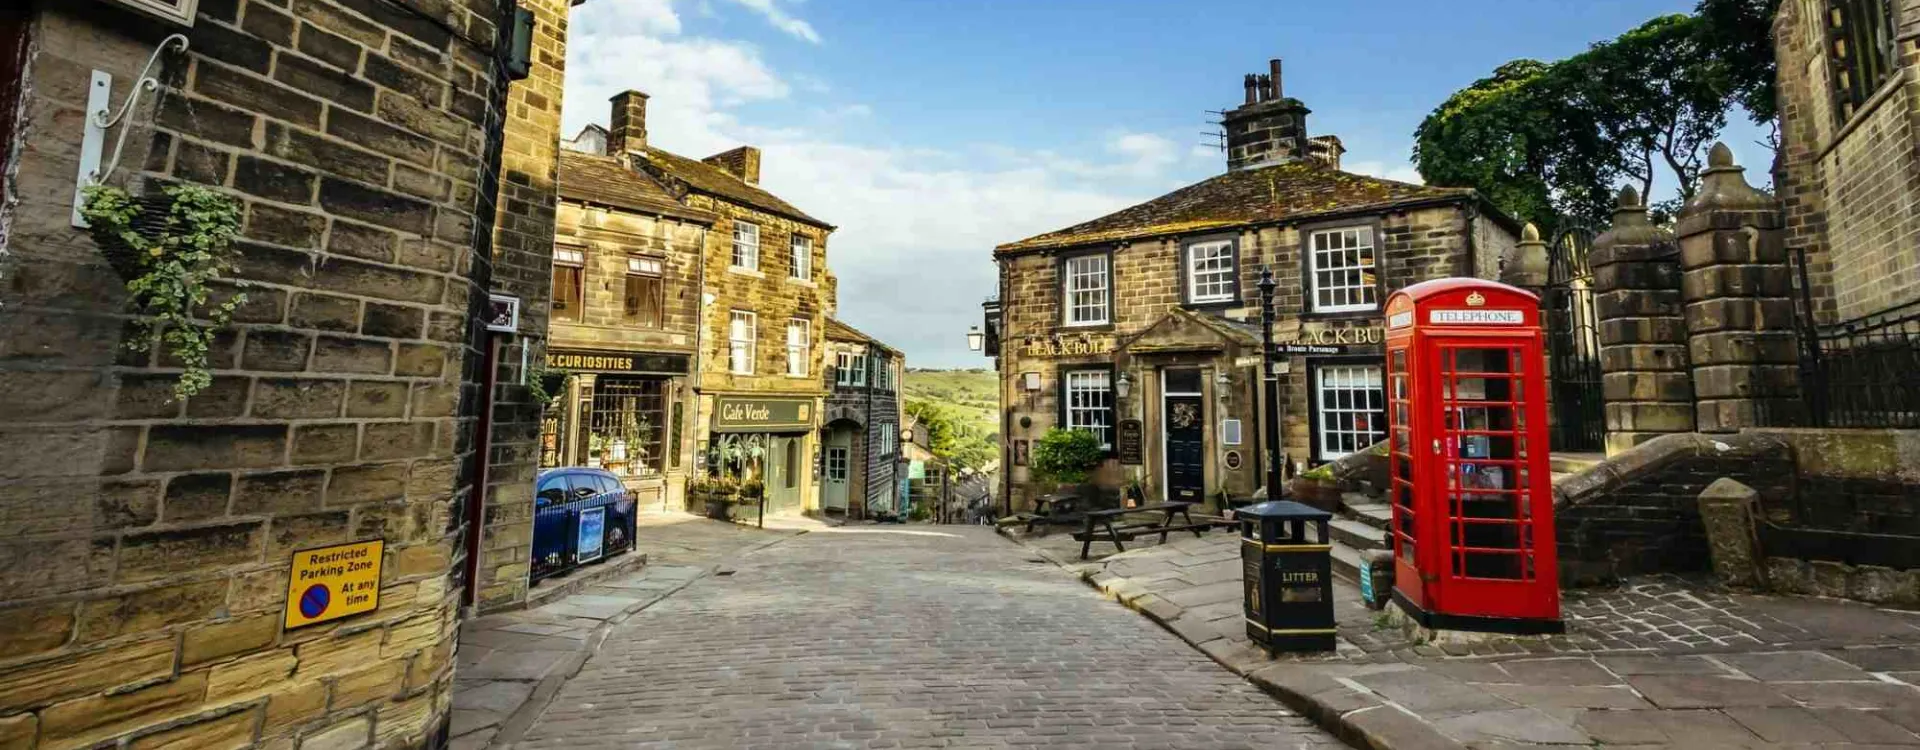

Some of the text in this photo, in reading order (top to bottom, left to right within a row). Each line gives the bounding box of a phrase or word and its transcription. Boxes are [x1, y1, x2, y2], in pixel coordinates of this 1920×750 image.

[1439, 311, 1516, 321] TELEPHONE
[1286, 328, 1350, 345] ACK
[557, 355, 633, 370] CURIOSITIES
[723, 403, 769, 420] Cafe Verde
[309, 548, 368, 565] Restricted
[300, 560, 373, 580] Parking Zone
[1282, 572, 1319, 582] LITTER
[341, 579, 375, 593] At any
[346, 594, 369, 606] time
